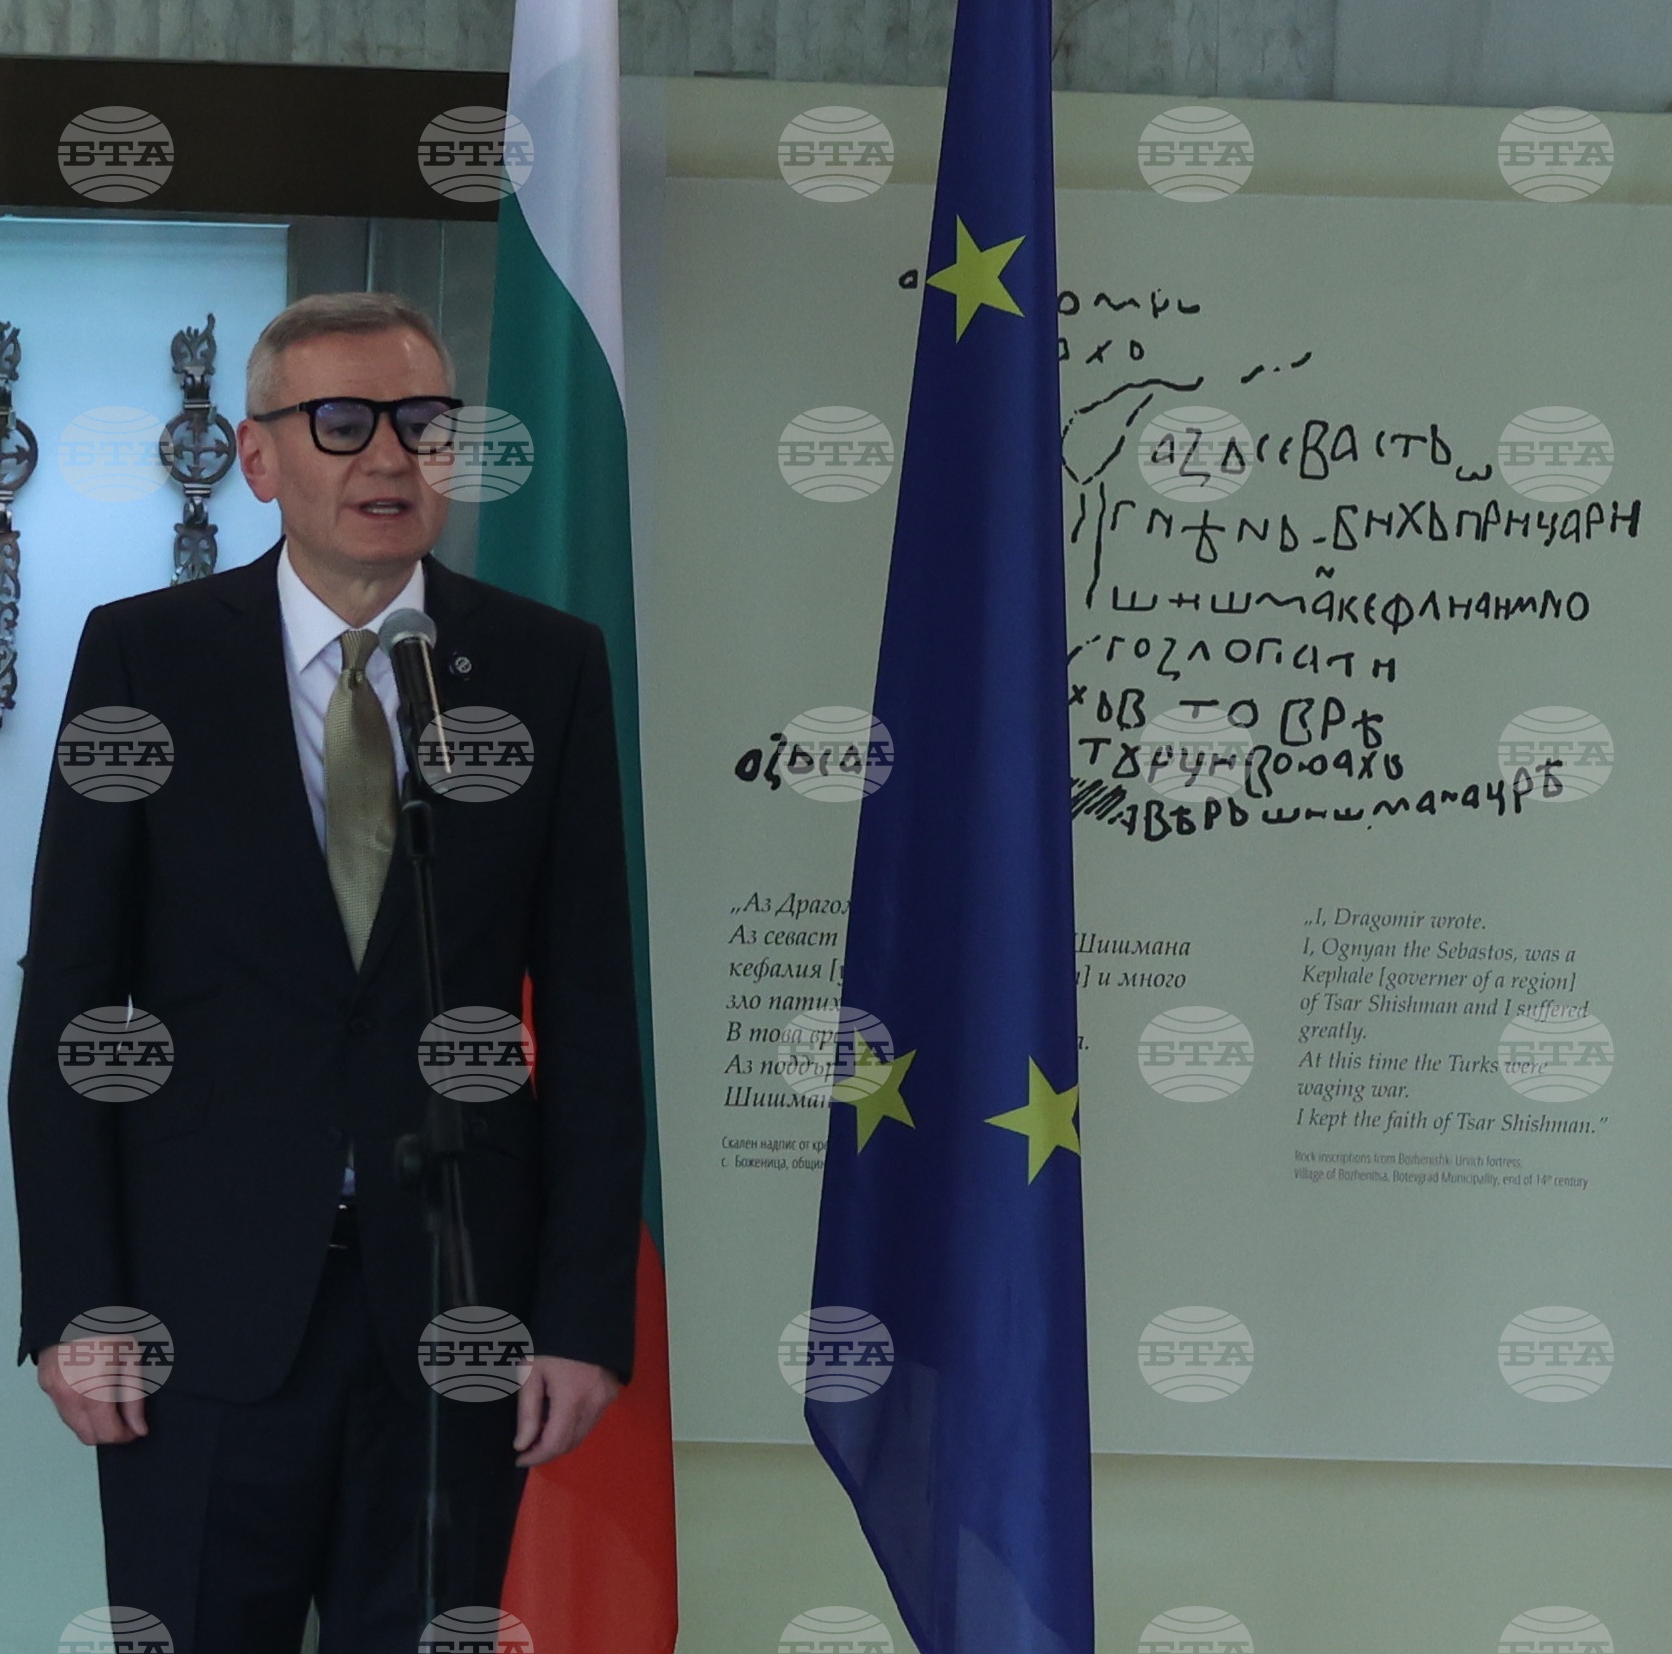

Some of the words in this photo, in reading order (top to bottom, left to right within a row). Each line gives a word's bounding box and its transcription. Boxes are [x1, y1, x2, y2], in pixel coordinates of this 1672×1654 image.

[1333, 907, 1425, 933] Dragomir
[1430, 913, 1486, 930] wrote.
[727, 923, 758, 945] Аз
[763, 929, 839, 947] севаст
[1321, 937, 1397, 963] Ognyan
[1403, 939, 1431, 959] the
[1436, 940, 1518, 963] Sebastos,
[1525, 948, 1560, 963] was
[1564, 949, 1576, 963] a
[729, 957, 823, 982] кефалия
[1097, 971, 1111, 987] и
[1116, 971, 1187, 989] много
[1301, 964, 1374, 987] Kephale
[1378, 965, 1468, 992] [governer
[1472, 969, 1493, 993] of
[1494, 975, 1505, 989] a
[1510, 971, 1577, 996] region]
[725, 994, 762, 1010] зло
[1299, 991, 1321, 1017] of
[1323, 992, 1363, 1012] Tsar
[1367, 993, 1458, 1015] Shishman
[1462, 997, 1499, 1016] and
[1503, 997, 1513, 1017] I
[1514, 998, 1592, 1024] suffered
[725, 1019, 743, 1043] В
[748, 1021, 803, 1046] това
[1297, 1020, 1367, 1046] greatly.
[723, 1053, 754, 1076] Аз
[1297, 1050, 1323, 1069] At
[1327, 1049, 1362, 1070] this
[1367, 1051, 1409, 1072] time
[1413, 1052, 1443, 1072] the
[1447, 1053, 1499, 1074] Turks
[1504, 1058, 1550, 1078] were
[1297, 1079, 1366, 1103] waging
[1371, 1084, 1409, 1099] war.
[1296, 1107, 1305, 1126] I
[1308, 1107, 1348, 1133] kept
[1353, 1109, 1382, 1128] the
[1383, 1109, 1428, 1134] faith
[1432, 1111, 1454, 1136] of
[1456, 1112, 1496, 1131] Tsar
[1502, 1174, 1522, 1187] end
[1554, 1176, 1589, 1191] century
